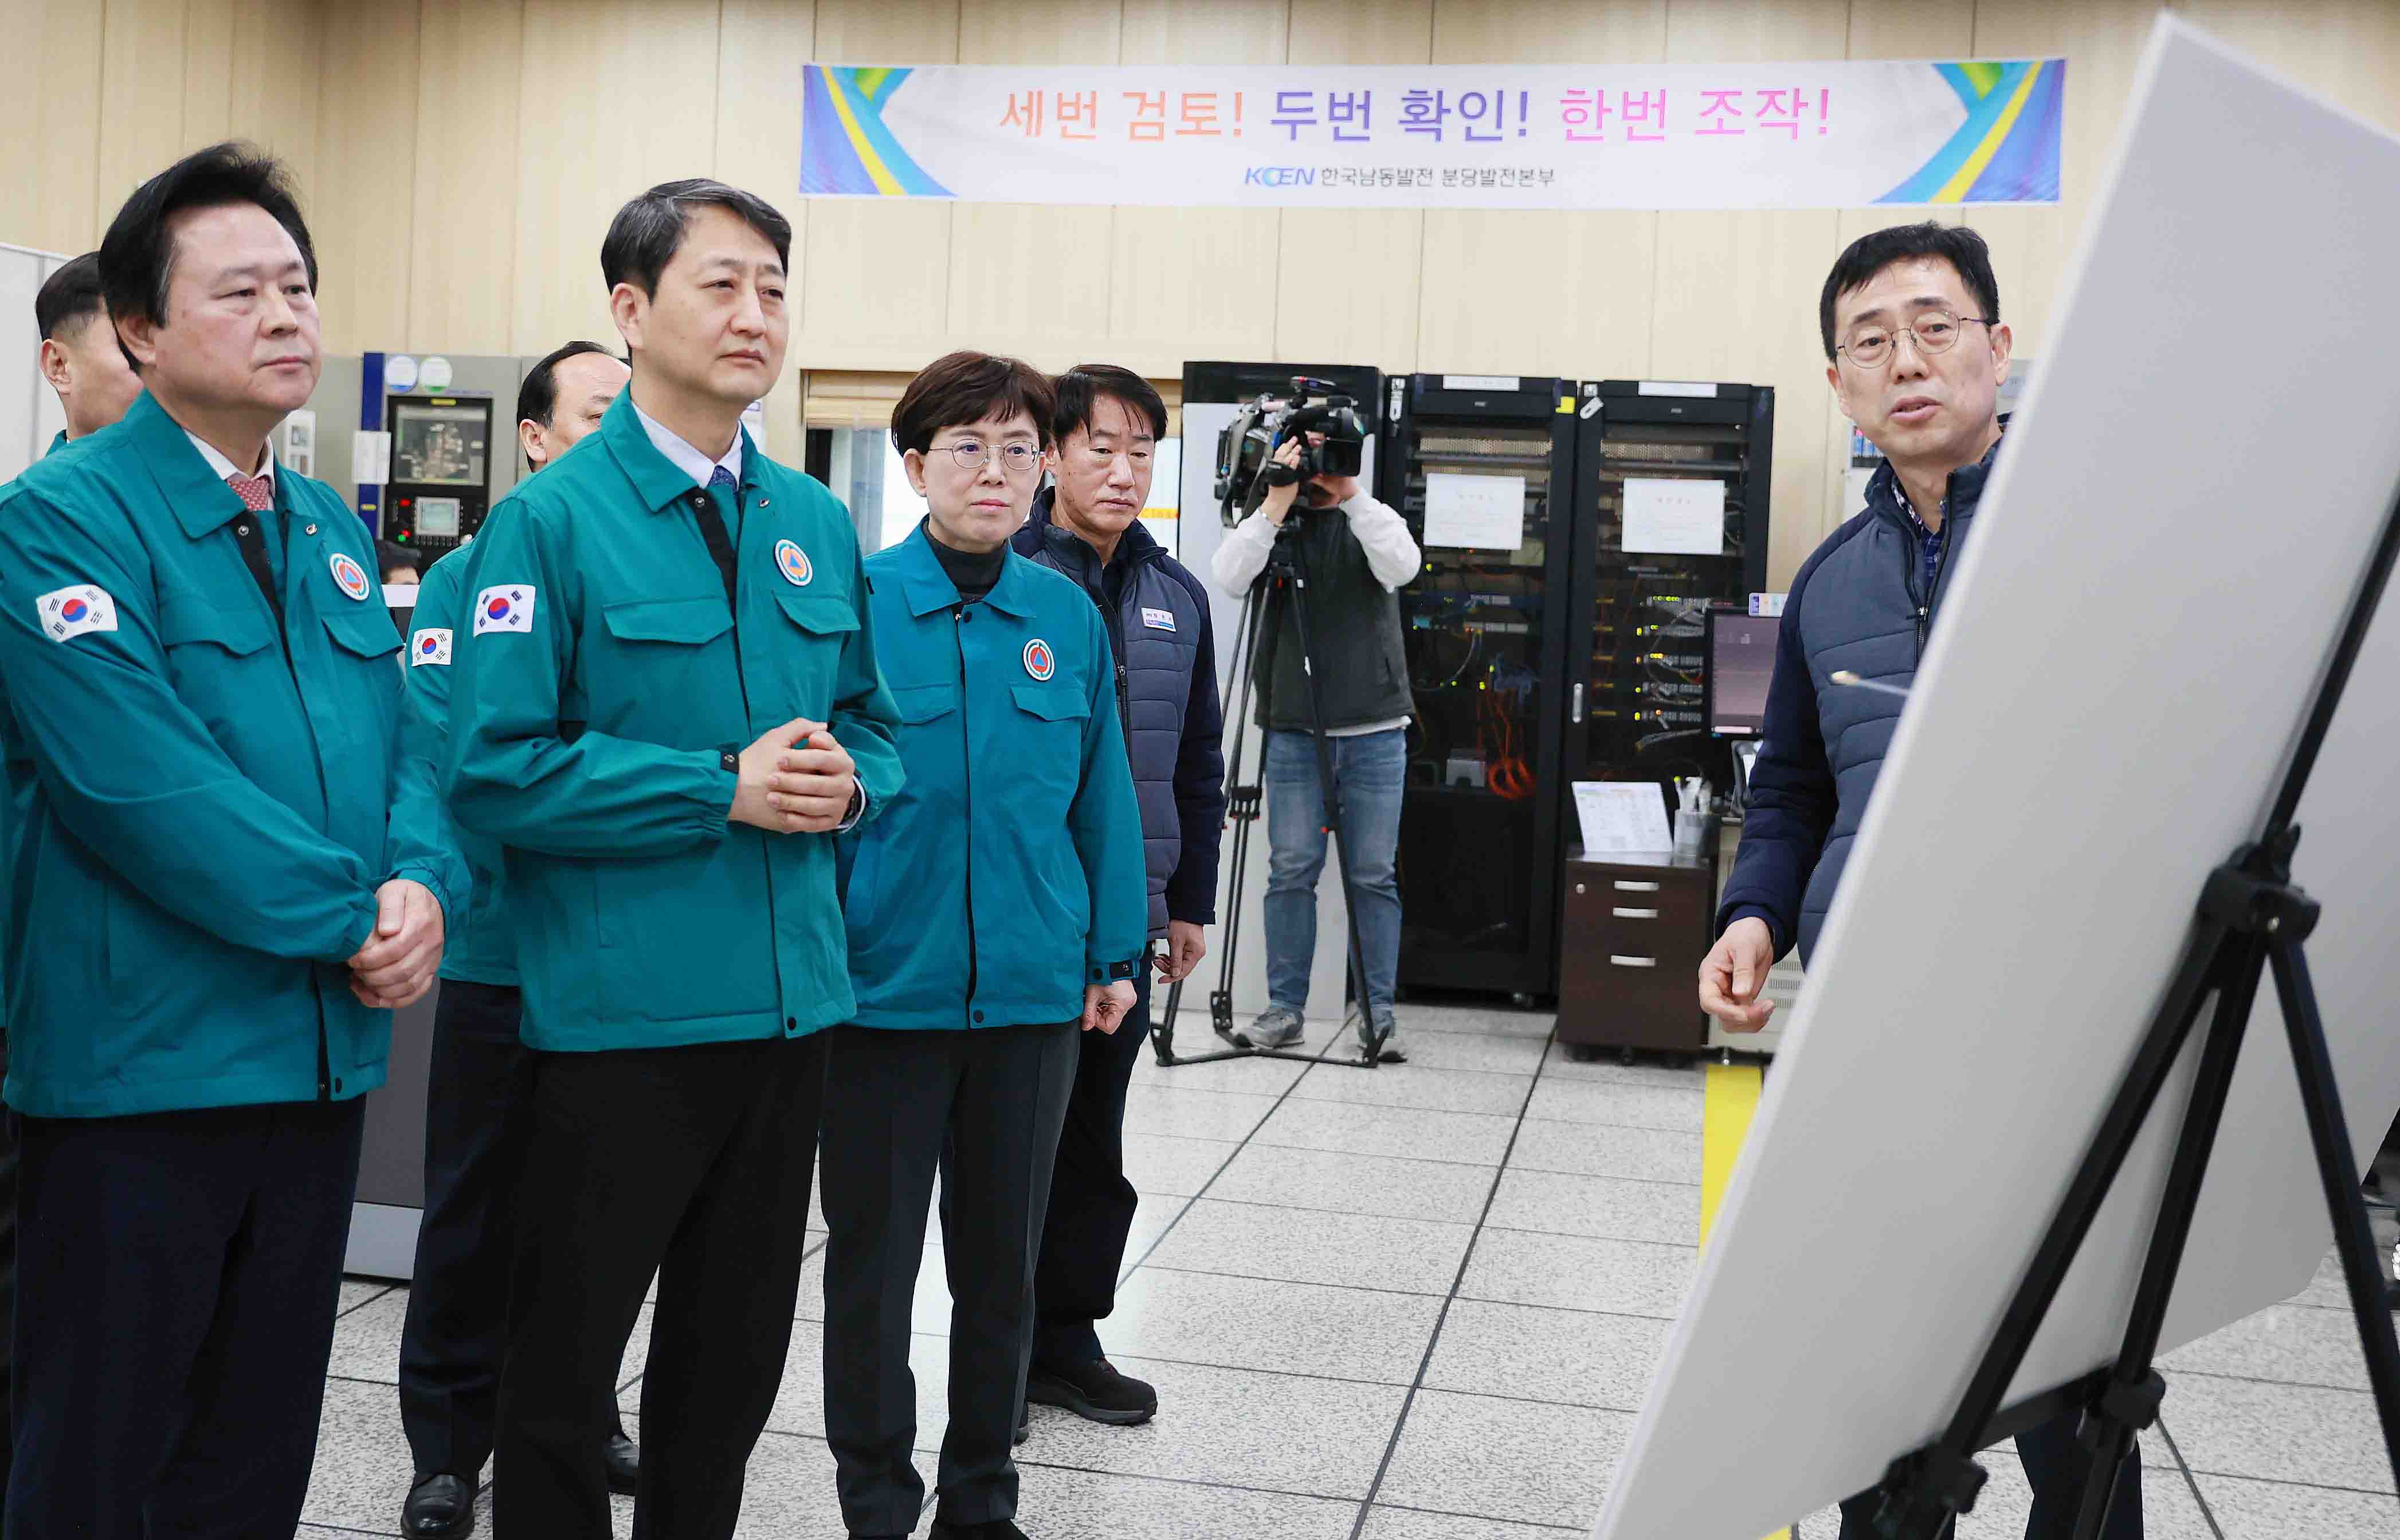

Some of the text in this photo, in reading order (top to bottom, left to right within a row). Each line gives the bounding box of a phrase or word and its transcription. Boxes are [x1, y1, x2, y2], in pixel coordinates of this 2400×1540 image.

[999, 87, 1830, 143] 세번 검토! 두번 확인! 한번 조작!
[1321, 167, 1434, 188] 한국남동발전
[1442, 167, 1555, 188] 분당발전본부
